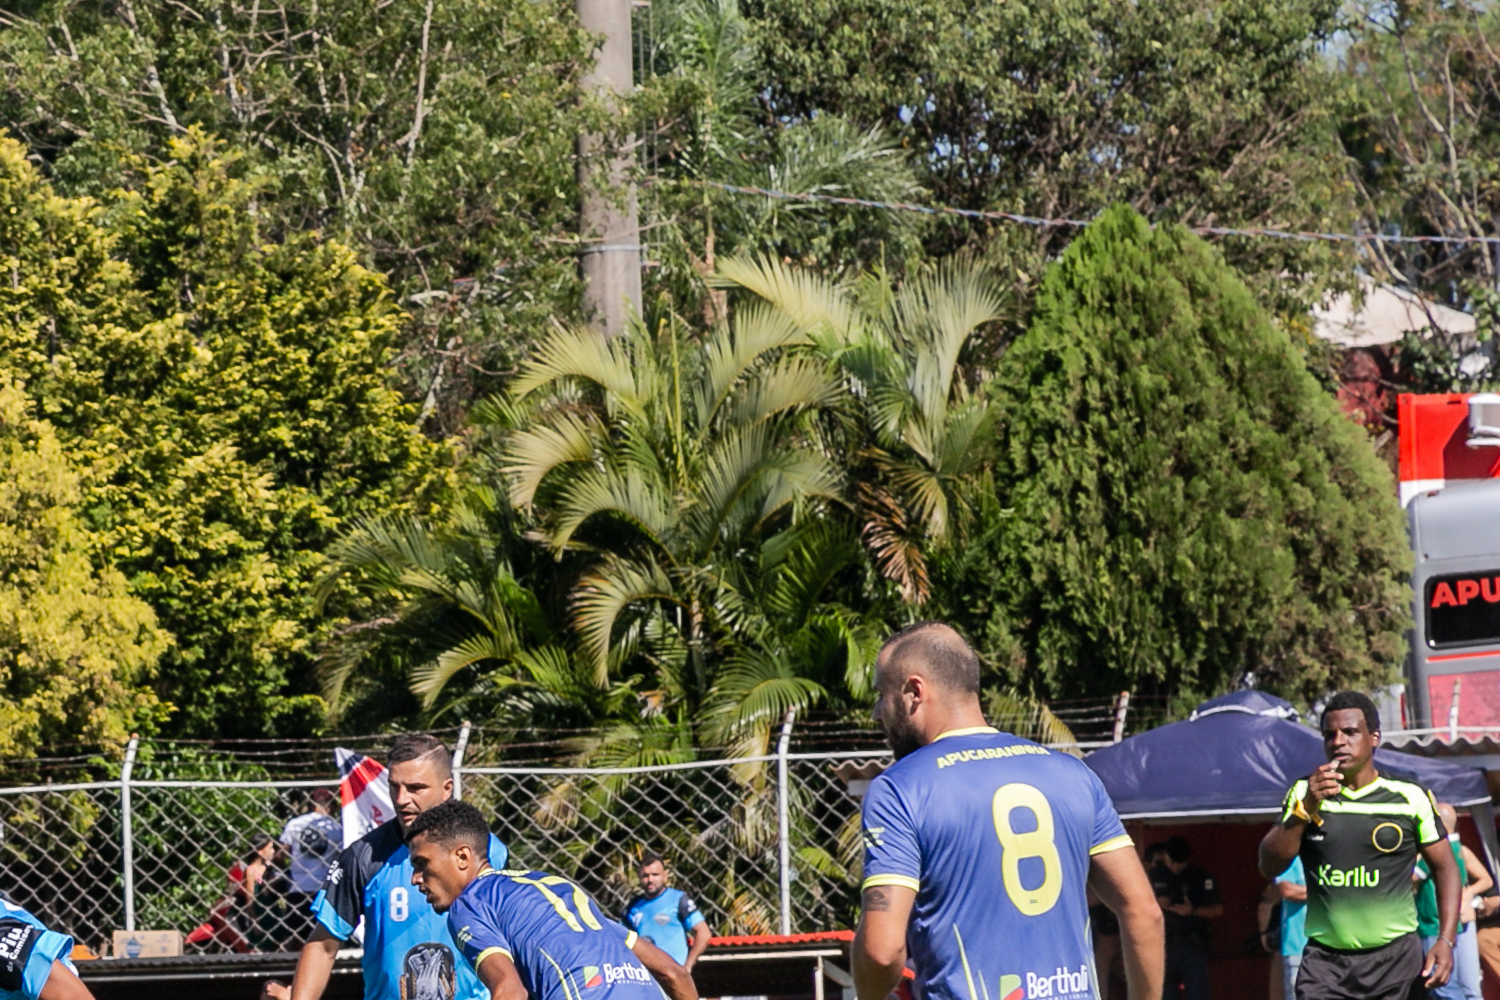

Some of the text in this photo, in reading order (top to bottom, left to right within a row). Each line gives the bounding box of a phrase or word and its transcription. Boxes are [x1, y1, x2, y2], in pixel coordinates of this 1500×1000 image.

[936, 744, 1050, 769] APUCARANINHA
[992, 782, 1062, 917] 8
[390, 886, 409, 922] 8
[512, 875, 603, 932] 17
[1026, 964, 1089, 1000] Bertholi
